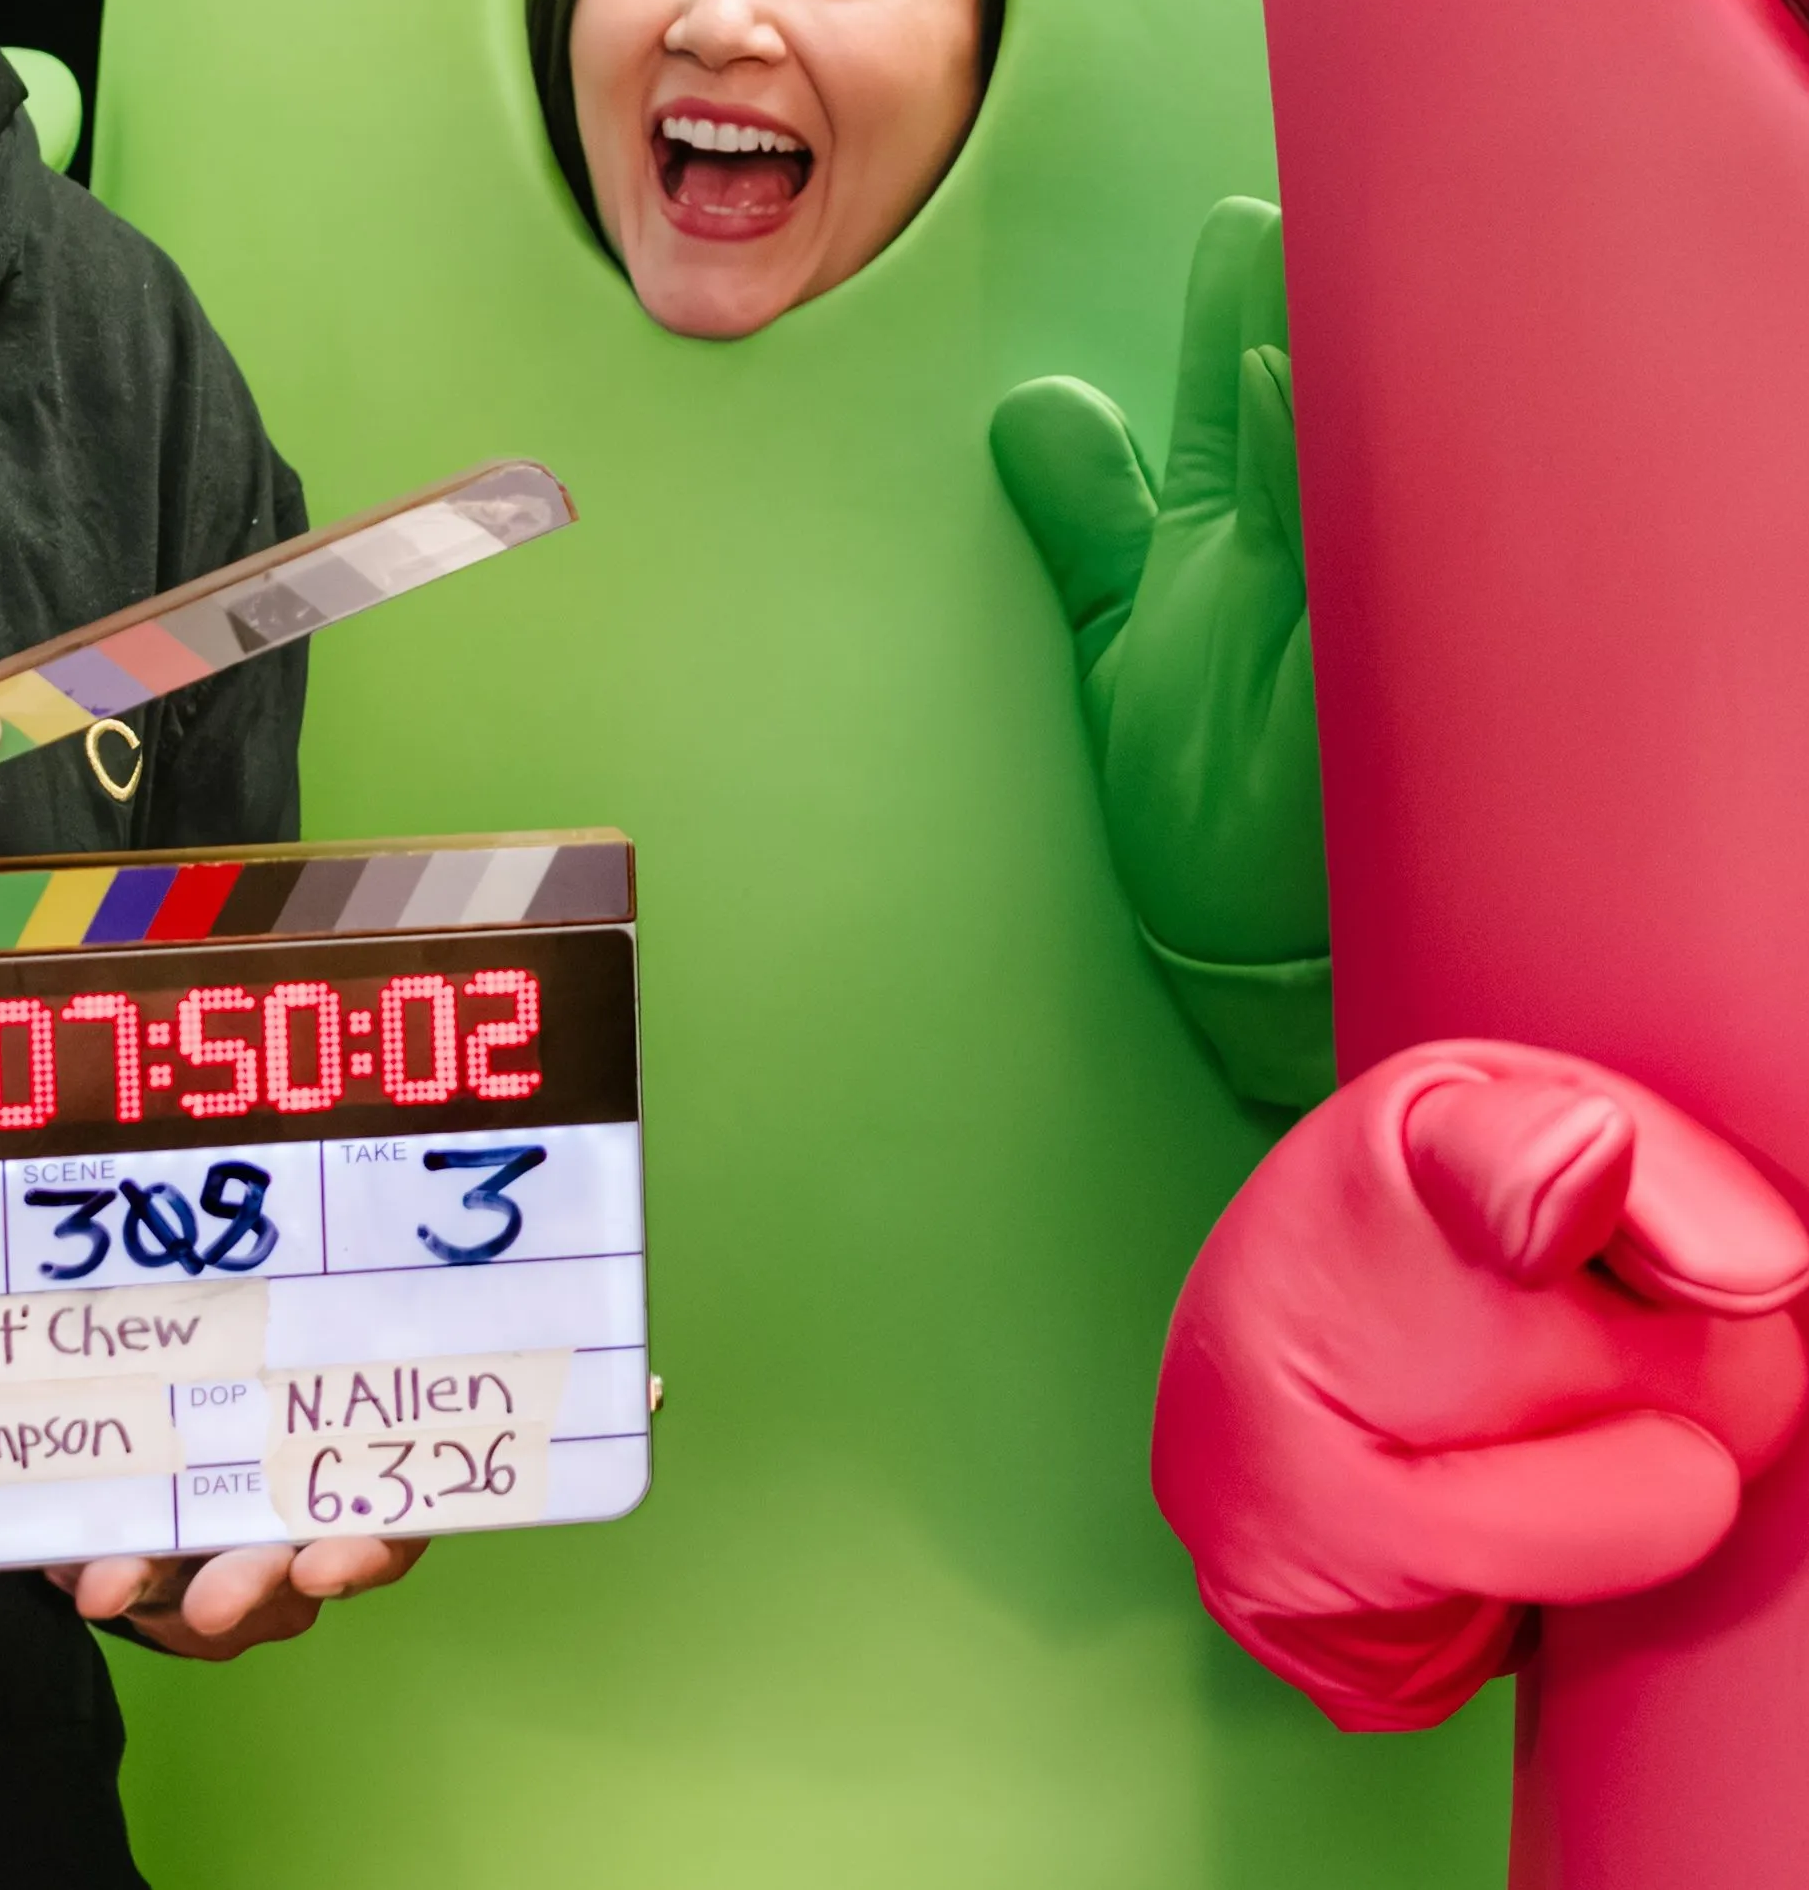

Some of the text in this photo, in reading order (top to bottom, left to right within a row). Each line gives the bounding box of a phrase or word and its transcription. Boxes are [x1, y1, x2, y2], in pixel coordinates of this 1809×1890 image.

[339, 1140, 409, 1163] TAKE
[23, 1158, 117, 1185] SCENE
[416, 1144, 547, 1265] 3
[47, 1300, 202, 1357] Chew
[190, 1384, 247, 1408] DOP
[193, 1472, 261, 1496] DATE
[307, 1430, 517, 1525] 6.3.26
